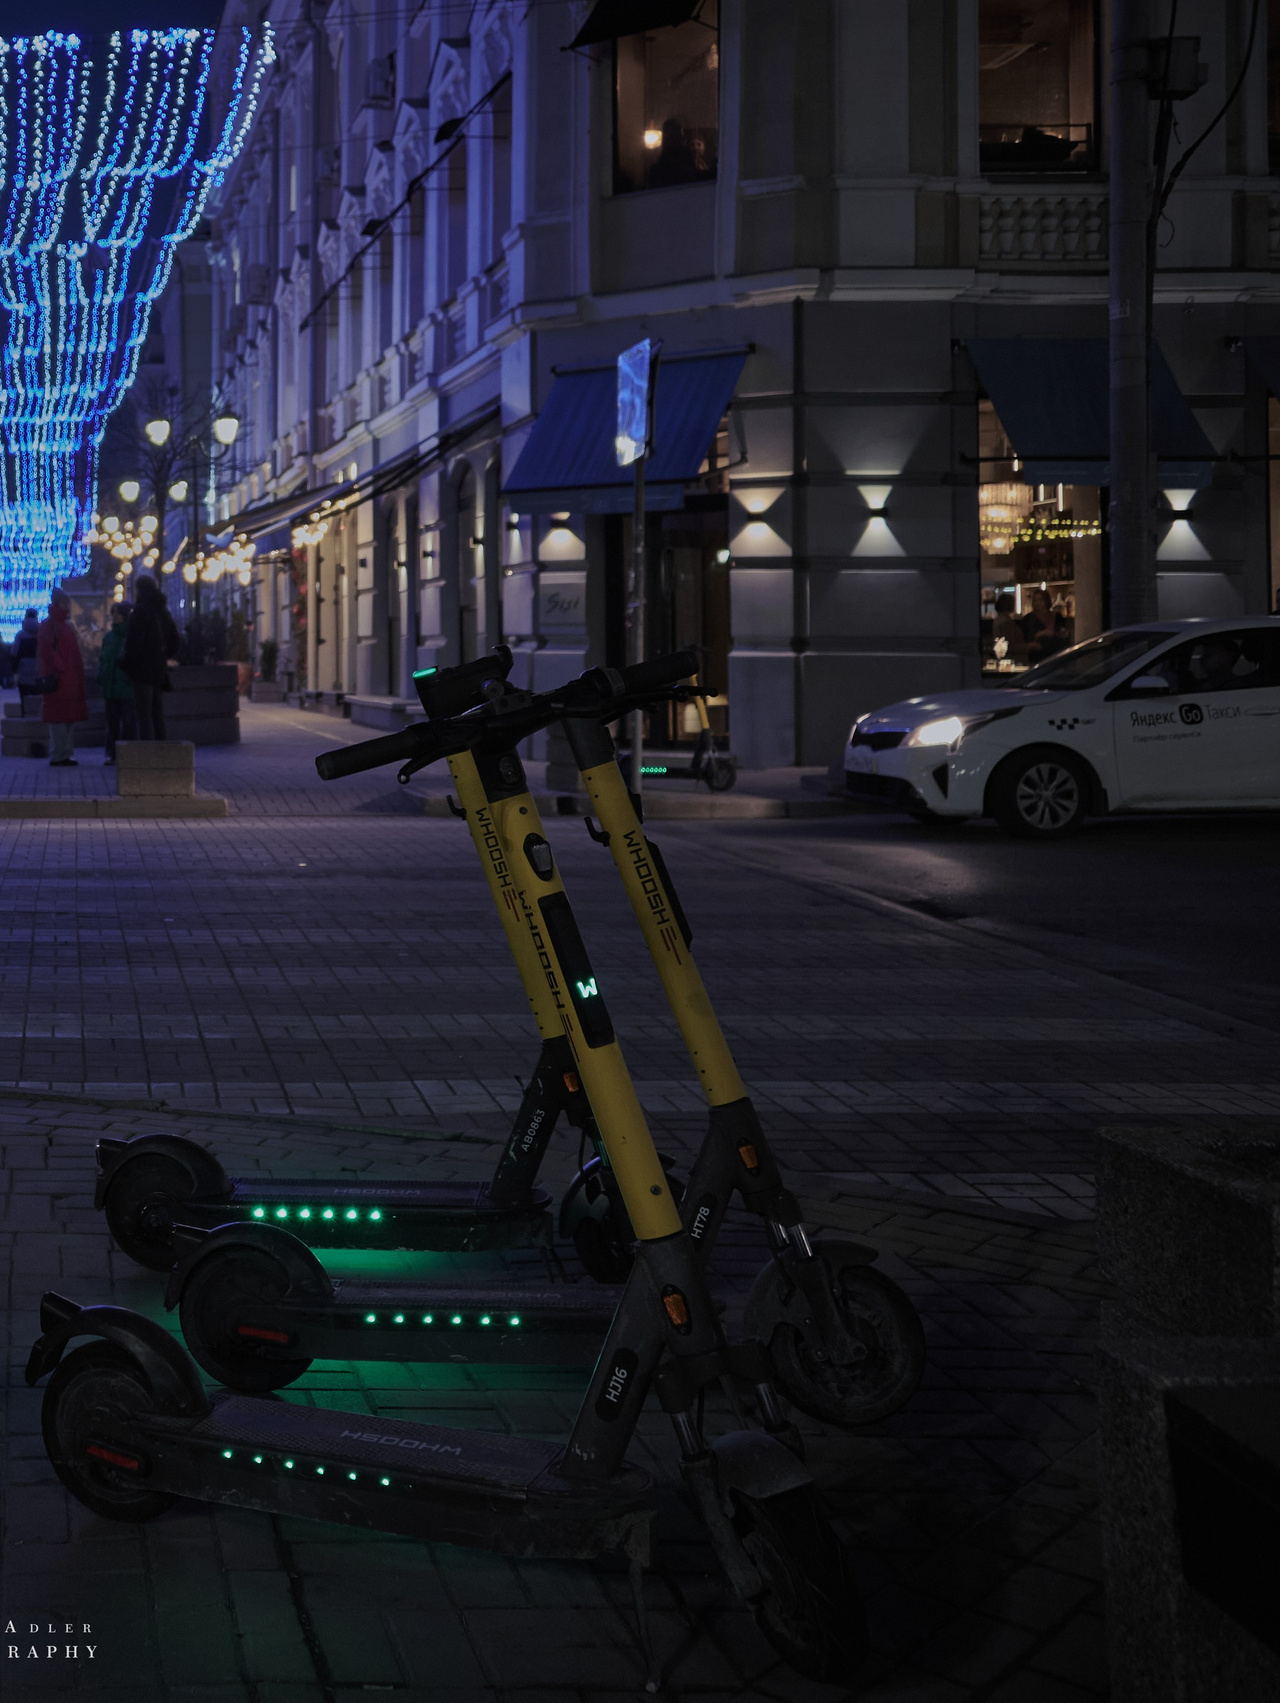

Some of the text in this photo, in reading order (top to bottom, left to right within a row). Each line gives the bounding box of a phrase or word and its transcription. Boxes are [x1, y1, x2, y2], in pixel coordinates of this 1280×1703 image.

[1130, 704, 1241, 727] Яндекс Go Такси
[476, 807, 512, 888] WHOOSH
[623, 829, 670, 926] WHOOSH
[518, 889, 566, 1009] WHOOSH
[576, 977, 598, 999] W
[520, 1109, 546, 1152] AB0863
[690, 1206, 710, 1239] HT78
[605, 1366, 628, 1403] HJ16
[339, 1430, 463, 1456] WHOOSH
